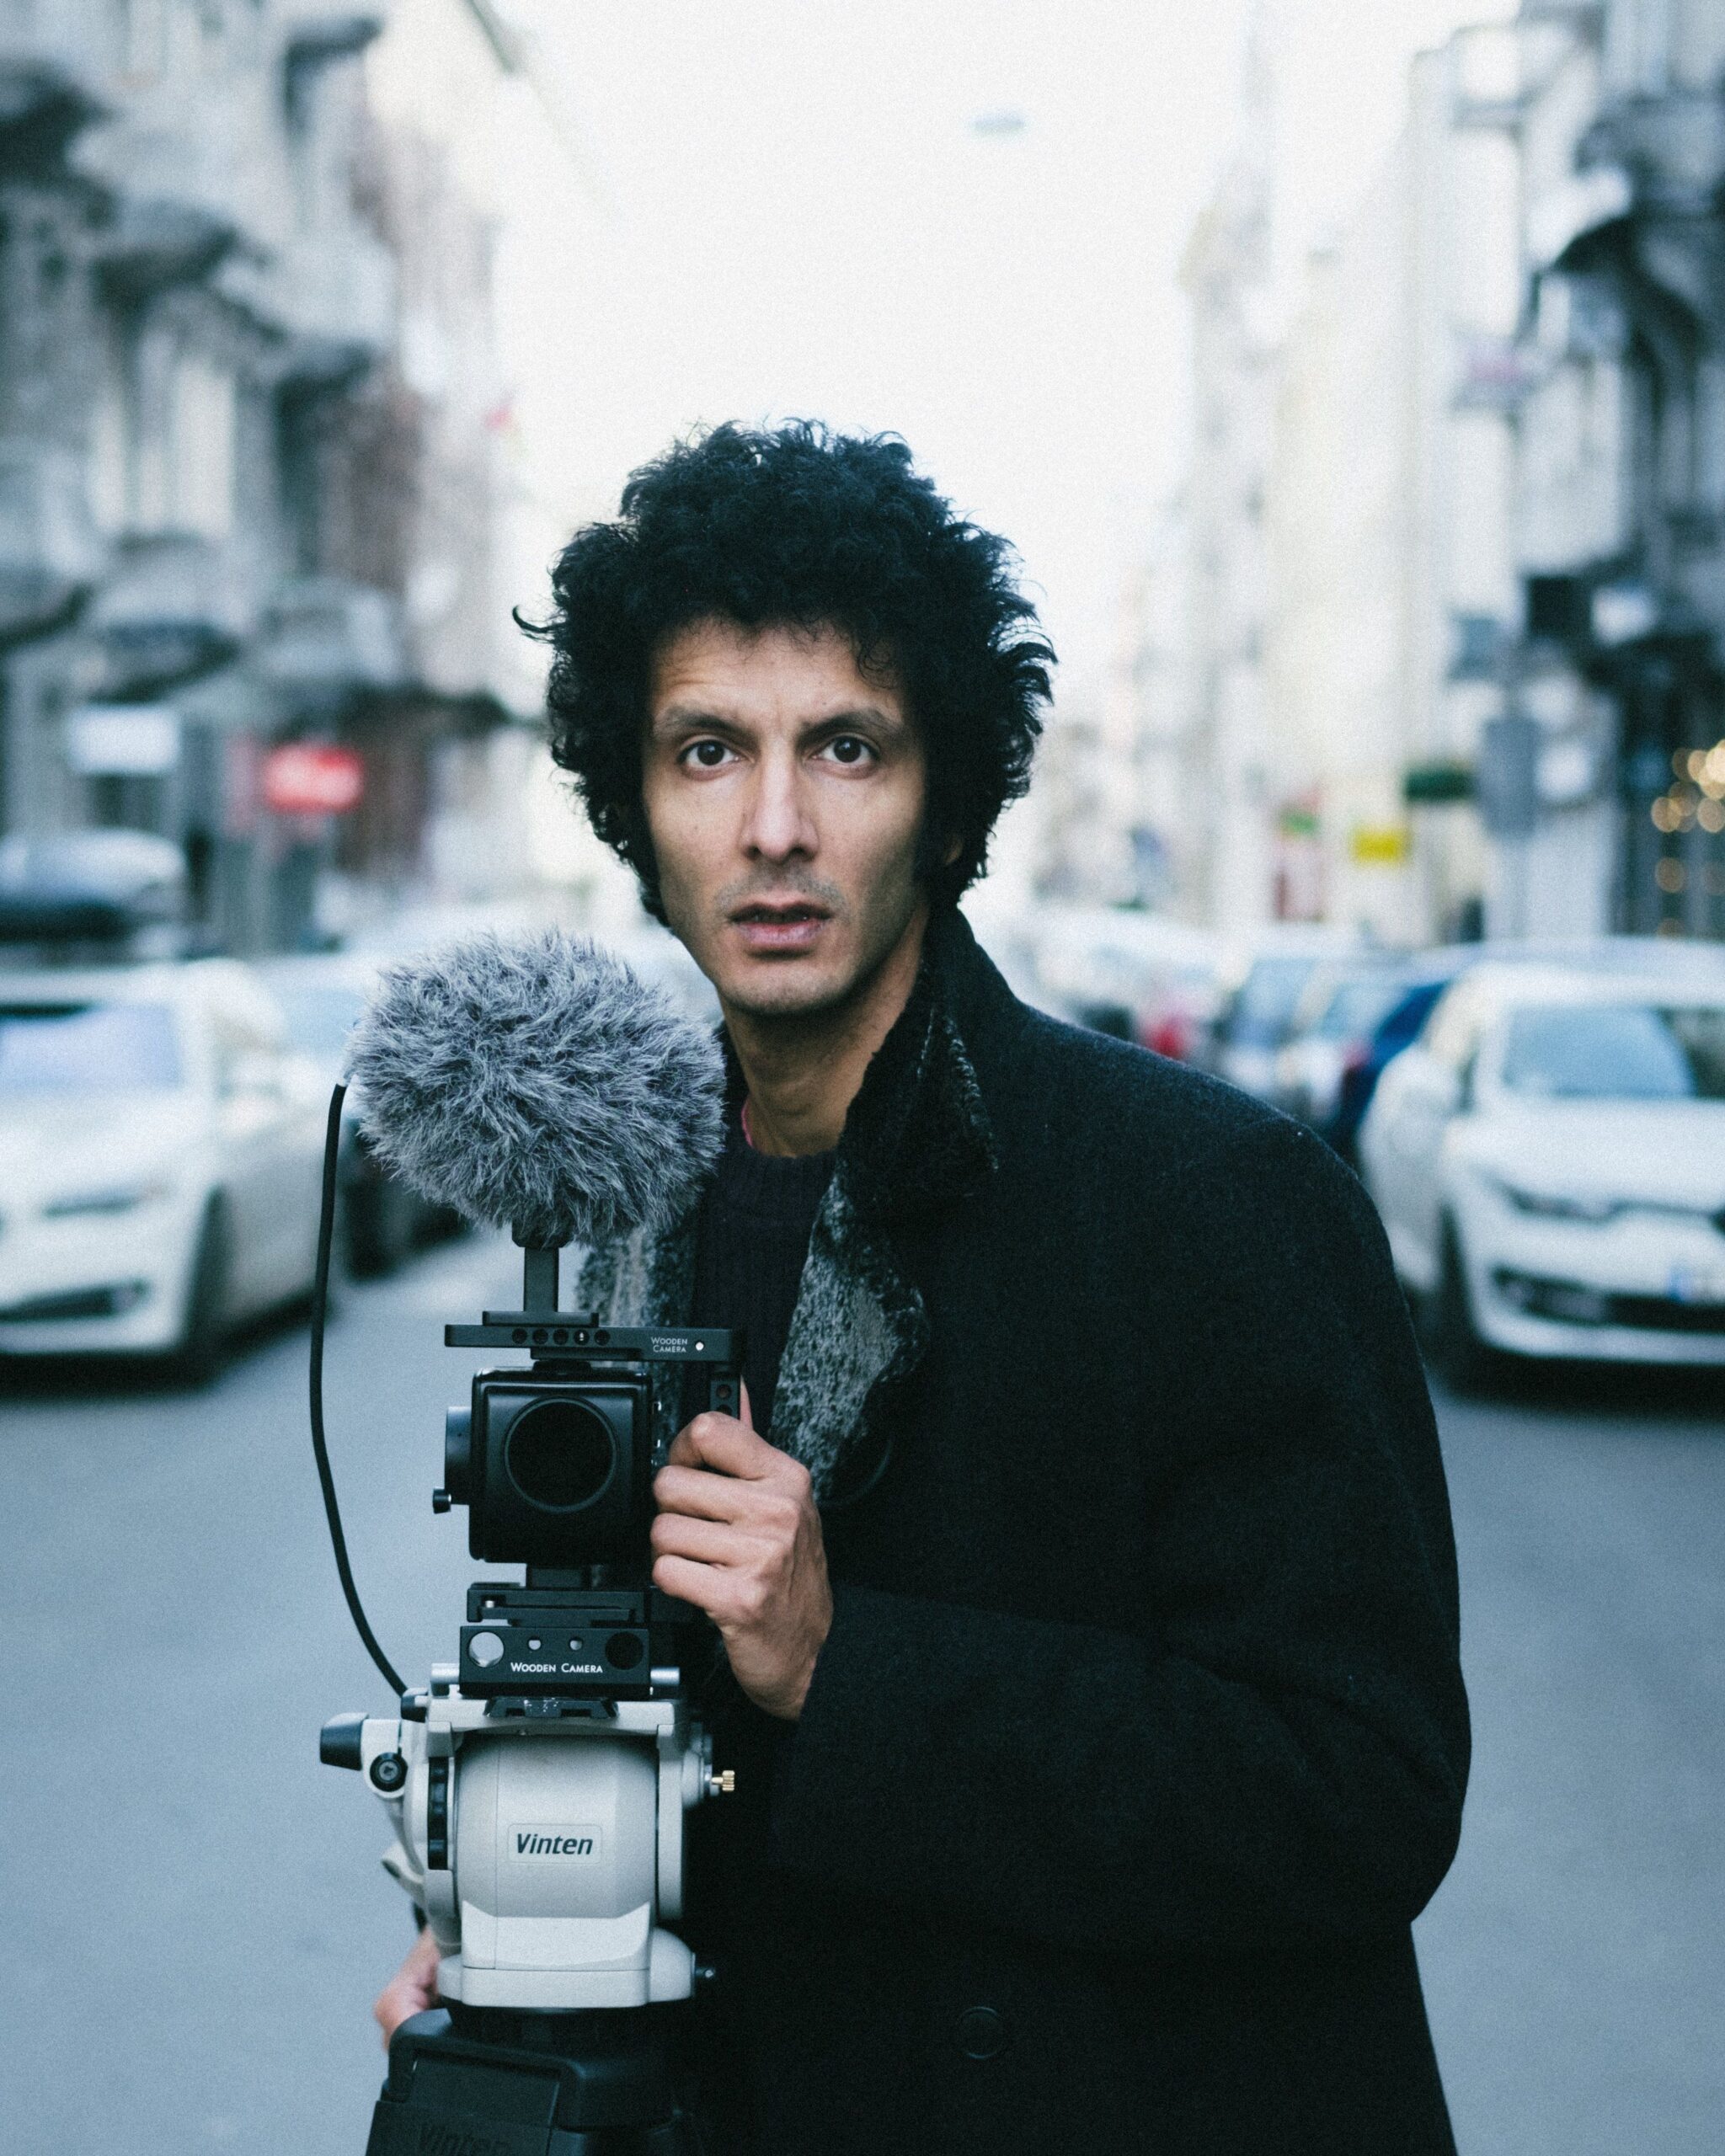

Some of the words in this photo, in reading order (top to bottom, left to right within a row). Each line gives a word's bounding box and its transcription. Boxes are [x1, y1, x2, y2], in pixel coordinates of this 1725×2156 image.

[651, 1337, 688, 1345] WOODEN
[510, 1662, 556, 1673] WOODEN
[561, 1662, 603, 1673] CAMERA
[517, 1833, 593, 1854] Vinten
